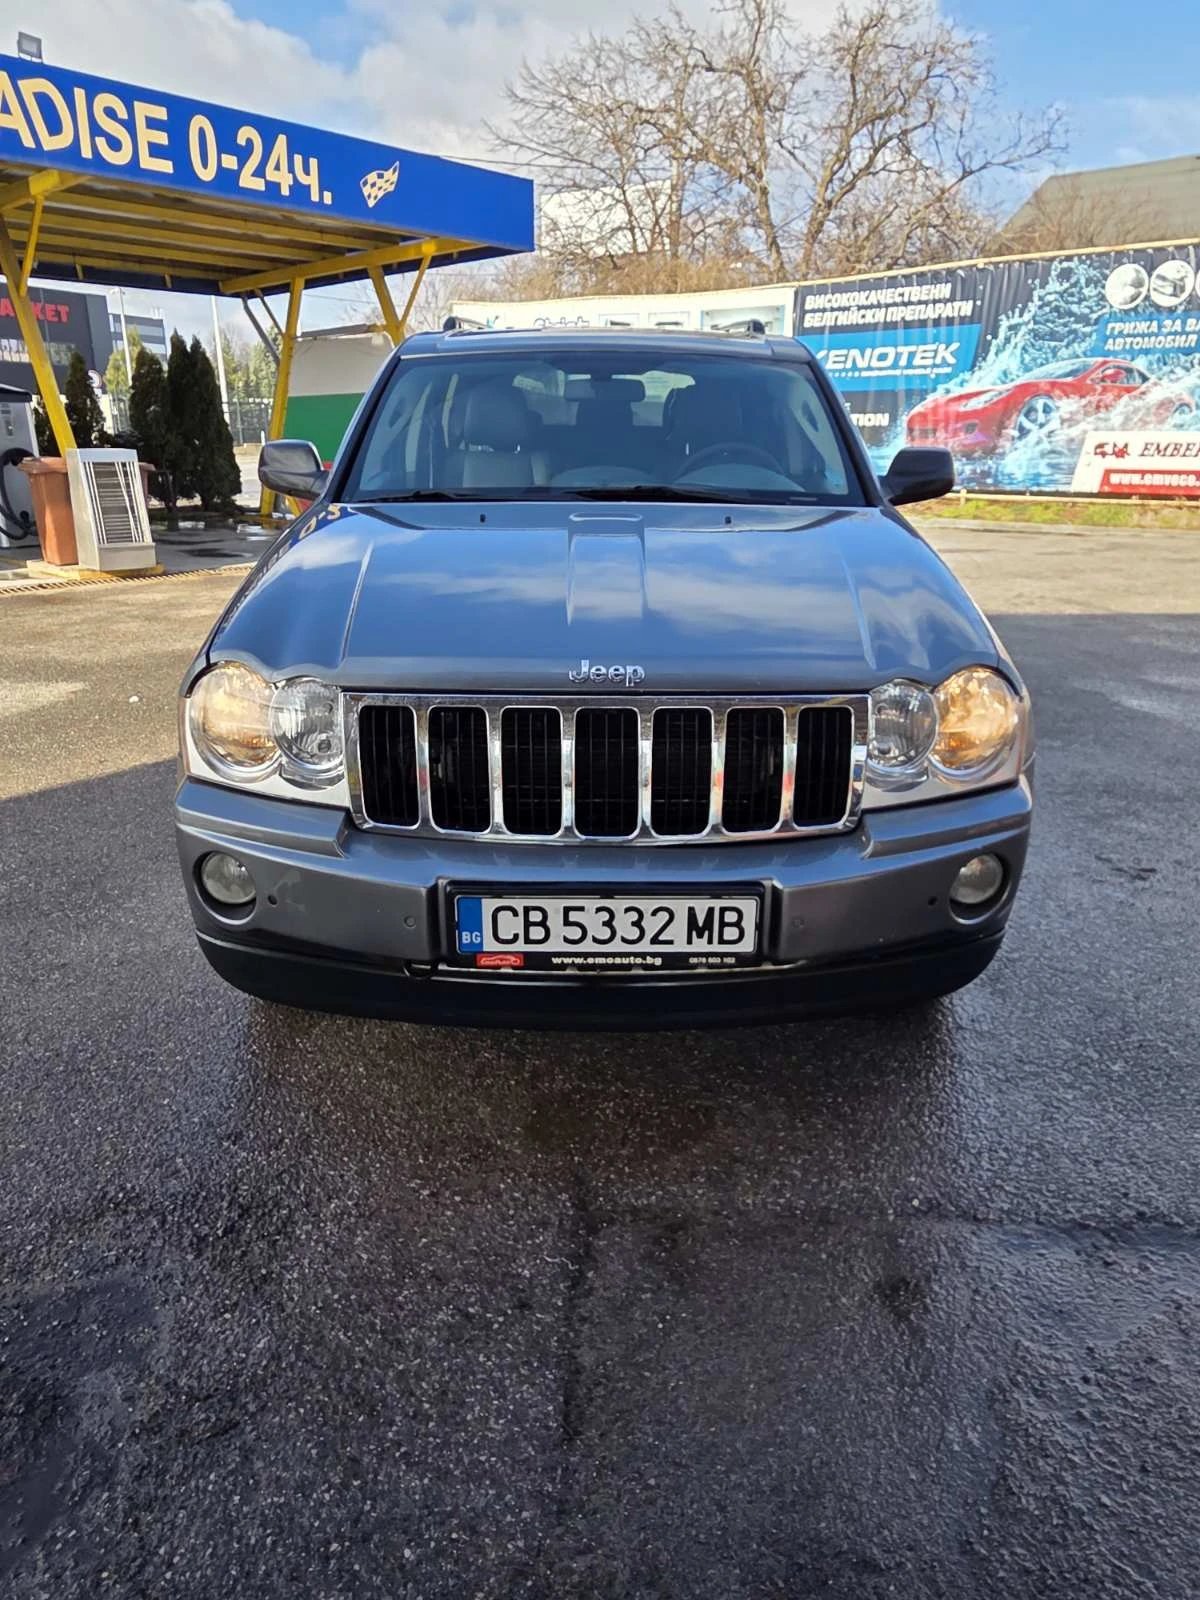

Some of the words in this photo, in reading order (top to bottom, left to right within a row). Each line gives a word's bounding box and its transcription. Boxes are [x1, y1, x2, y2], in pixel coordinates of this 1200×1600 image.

[0, 70, 174, 174] ADISE
[804, 283, 952, 310] ВИСОКОКАЧЕСТВЕНИ
[0, 298, 69, 323] AKET
[803, 306, 886, 328] БЕЛГИЙСКИ
[886, 300, 974, 322] ПРЕПАРАТИ
[1105, 320, 1158, 335] ГРИЖА
[1161, 319, 1182, 333] ЗА
[1104, 334, 1198, 351] АВТОМОБИЛ
[568, 659, 646, 687] Jeep
[461, 931, 481, 944] BG
[491, 905, 551, 945] CB
[563, 905, 675, 945] 5332
[686, 906, 745, 945] MB
[551, 956, 662, 966] www.emoauto.bg
